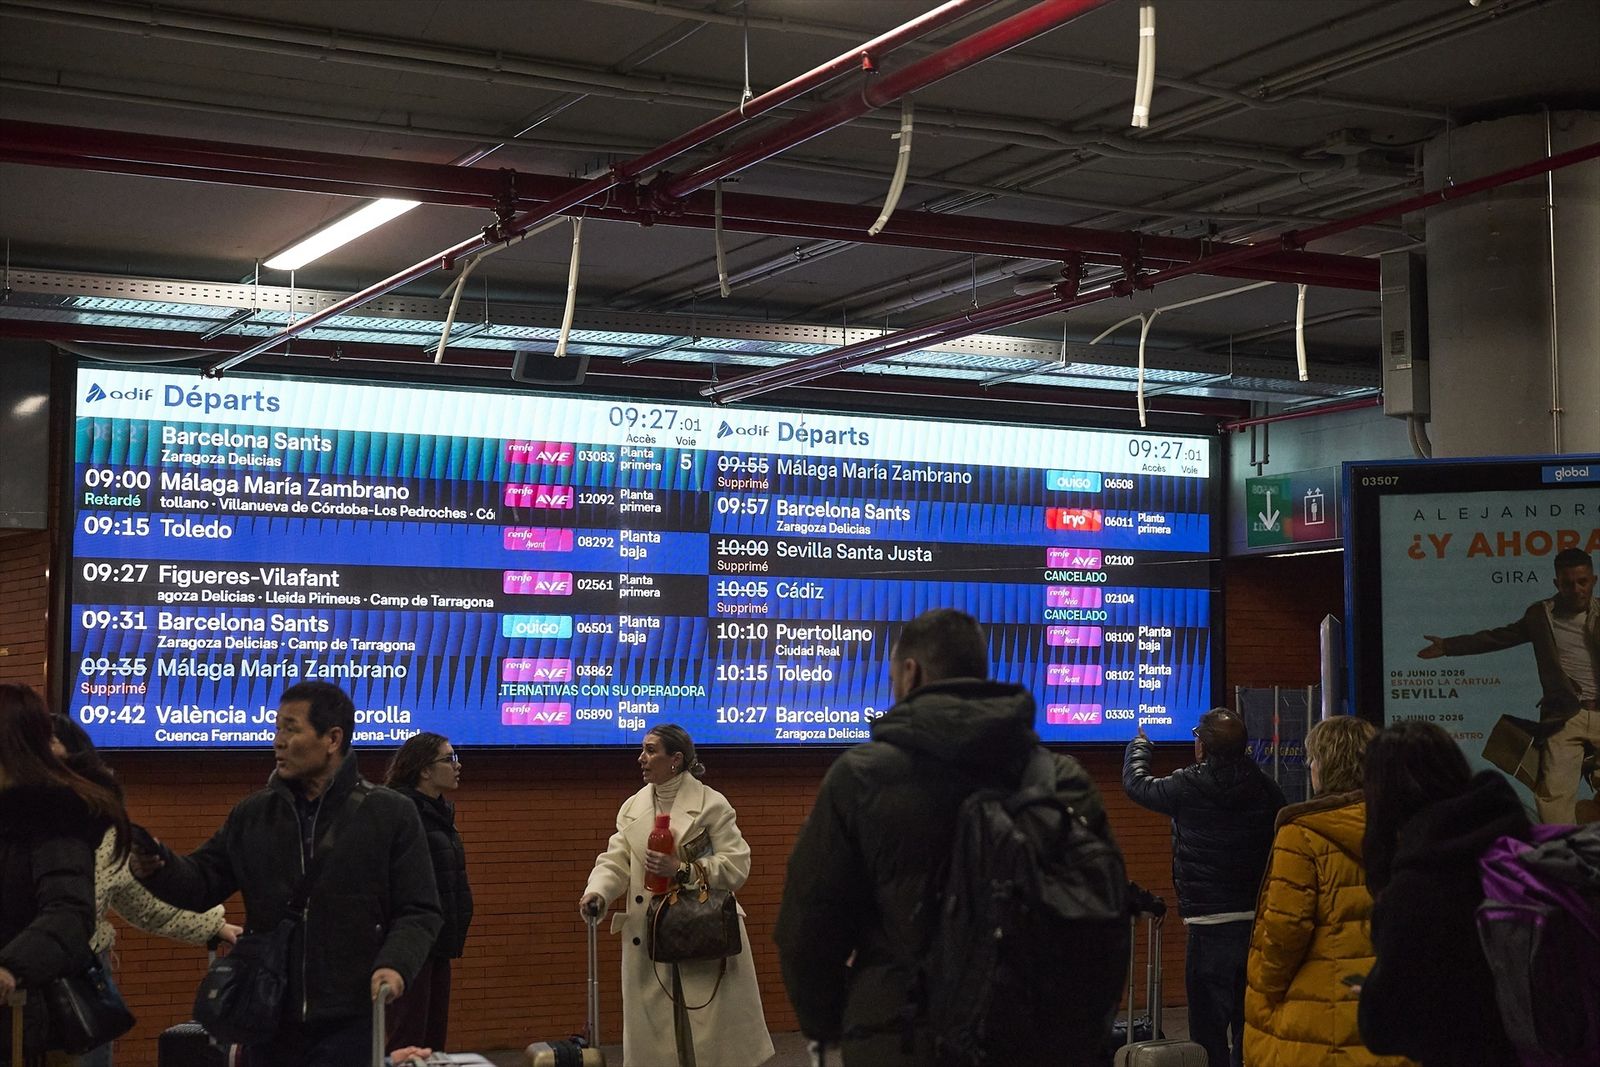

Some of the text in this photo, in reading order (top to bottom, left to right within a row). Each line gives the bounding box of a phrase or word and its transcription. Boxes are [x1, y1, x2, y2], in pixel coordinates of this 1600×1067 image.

[110, 387, 154, 401] adif
[164, 384, 280, 414] Départs
[609, 406, 678, 430] 09:27
[736, 425, 770, 436] adif
[778, 422, 870, 448] Départs
[162, 426, 269, 450] Barcelona
[273, 432, 332, 452] Sants
[626, 434, 656, 444] Accès
[676, 436, 696, 446] Voie
[620, 446, 654, 459] Planta
[1129, 439, 1182, 460] 09:27
[161, 450, 282, 467] Zaragoza Delicias
[536, 452, 570, 462] AVE
[578, 451, 615, 462] 03083
[680, 454, 691, 469] 5
[620, 459, 662, 472] primera
[718, 456, 769, 474] 09:55
[777, 458, 972, 484] Málaga María Zambrano
[1142, 463, 1166, 472] Accès
[1181, 465, 1198, 474] Voie
[85, 468, 151, 488] 09:00
[1555, 467, 1589, 481] global
[161, 472, 409, 500] Málaga María Zambrano
[718, 477, 769, 490] Supprimé
[1104, 479, 1134, 489] 06508
[1362, 477, 1399, 486] 03507
[84, 492, 141, 507] Retardé
[535, 495, 568, 506] AVE
[578, 493, 614, 505] 12092
[620, 489, 654, 501] Planta
[160, 496, 467, 519] tollano Villanueva de Córdoba-Los Pedroches
[620, 501, 662, 514] primera
[717, 497, 768, 515] 09:57
[777, 500, 911, 521] Barcelona Sants
[1413, 503, 1600, 520] ALEJANDR
[1105, 517, 1134, 527] 06011
[1138, 513, 1164, 523] Planta
[84, 516, 150, 536] 09:15
[161, 519, 232, 539] Toledo
[777, 521, 871, 535] Zaragoza Delicias
[1138, 525, 1171, 535] primera
[578, 536, 614, 548] 08292
[620, 530, 660, 543] Planta
[620, 544, 647, 558] baja
[717, 539, 768, 556] 10:00
[776, 541, 932, 562] Sevilla Santa Justa
[1407, 532, 1452, 560] ¿Y
[717, 560, 768, 574] Supprimé
[1072, 558, 1098, 567] AVE
[1105, 556, 1134, 565] 02100
[83, 563, 149, 583] 09:27
[158, 564, 340, 589] Figueres-Vilafant
[1044, 571, 1107, 582] CANCELADO
[1492, 571, 1538, 583] GIRA
[535, 581, 568, 592] AVE
[577, 579, 613, 590] 02561
[619, 574, 653, 586] Planta
[619, 587, 660, 599] primera
[717, 581, 768, 598] 10:05
[776, 582, 824, 600] Cádiz
[157, 590, 494, 610] agoza Delicias Lleida Pirineus Camp de Tarragona
[1105, 594, 1134, 604] 02104
[717, 602, 768, 615] Supprimé
[1044, 609, 1107, 621] CANCELADO
[82, 611, 147, 630] 09:31
[158, 612, 329, 633] Barcelona Sants
[619, 616, 660, 630] Planta
[576, 622, 613, 634] 06501
[717, 622, 768, 640] 10:10
[776, 624, 872, 642] Puertollano
[1139, 626, 1171, 638] Planta
[619, 631, 646, 645] baja
[1106, 632, 1134, 642] 08100
[157, 636, 417, 655] Zaragoza Delicias Camp de Tarragona
[776, 645, 840, 657] Ciudad Real
[1139, 640, 1160, 653] baja
[81, 658, 147, 676] 09:35
[157, 658, 407, 681] Málaga María Zambrano
[533, 668, 568, 679] AVE
[576, 665, 612, 676] 03862
[717, 664, 768, 681] 10:15
[776, 665, 833, 682] Toledo
[1139, 664, 1172, 675] Planta
[1106, 671, 1134, 681] 08102
[81, 682, 146, 698] Supprimé
[498, 684, 706, 697] TERNATIVAS CON SU OPERADORA
[1139, 678, 1161, 691] baja
[1391, 688, 1458, 699] SEVILLA
[80, 705, 146, 724] 09:42
[156, 705, 246, 725] València
[576, 709, 612, 720] 05890
[618, 702, 659, 715] Planta
[716, 707, 768, 723] 10:27
[776, 707, 860, 723] Barcelona
[1106, 710, 1134, 720] 03303
[1139, 704, 1166, 714] Planta
[533, 712, 568, 722] AVE
[618, 716, 646, 730] baja
[1072, 712, 1099, 722] AVE
[1139, 715, 1172, 726] primera
[1406, 714, 1436, 722] JUNIO
[155, 729, 276, 742] Cuenca Fernando
[776, 728, 870, 741] Zaragoza Delicias
